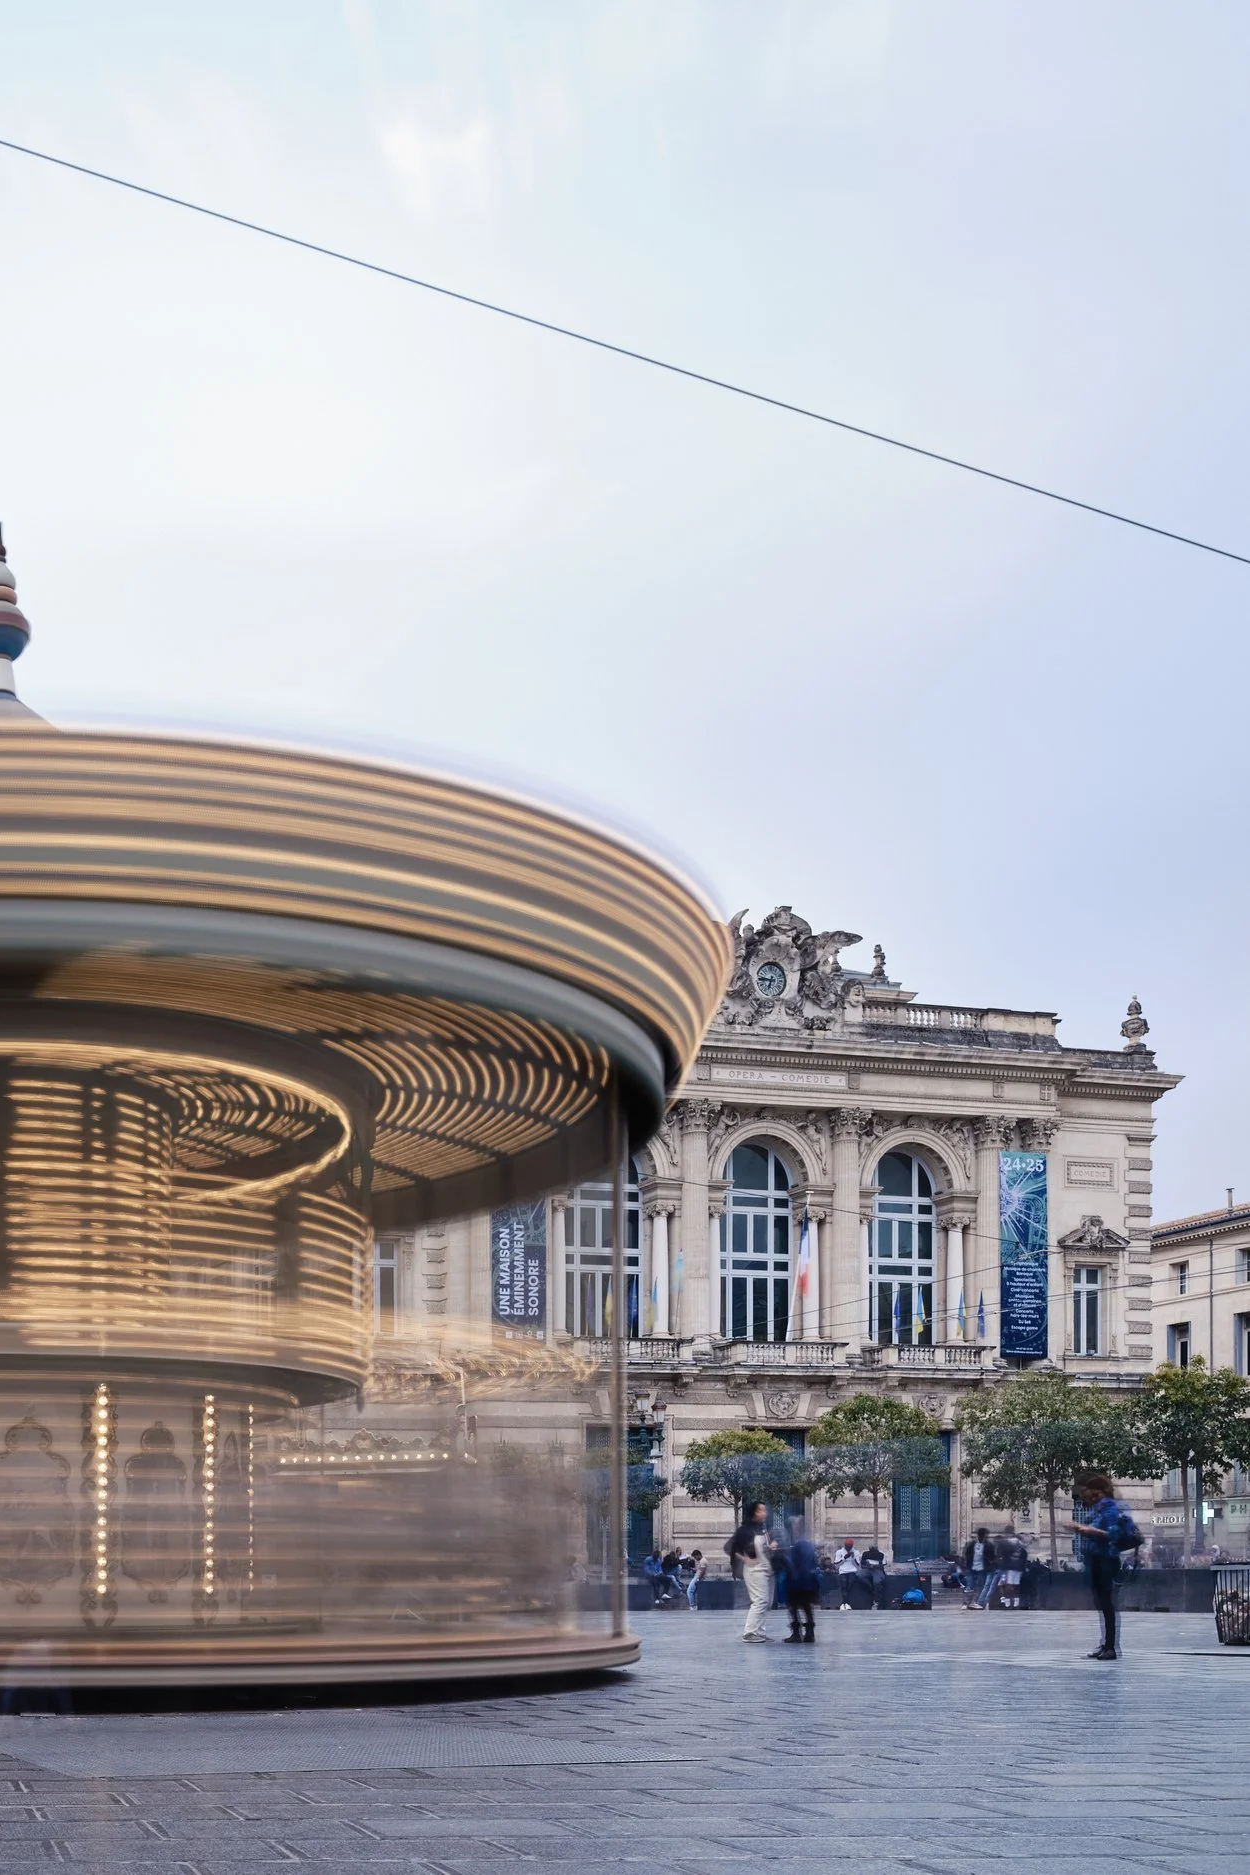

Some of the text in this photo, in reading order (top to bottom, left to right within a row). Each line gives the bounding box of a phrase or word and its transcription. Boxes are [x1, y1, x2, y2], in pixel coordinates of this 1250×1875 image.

[728, 1070, 765, 1080] OPERA
[781, 1073, 831, 1084] COMEDIE
[499, 1228, 510, 1316] UNE MAISON
[510, 1222, 525, 1316] ÉMINEMMENT
[528, 1259, 539, 1316] SONORE
